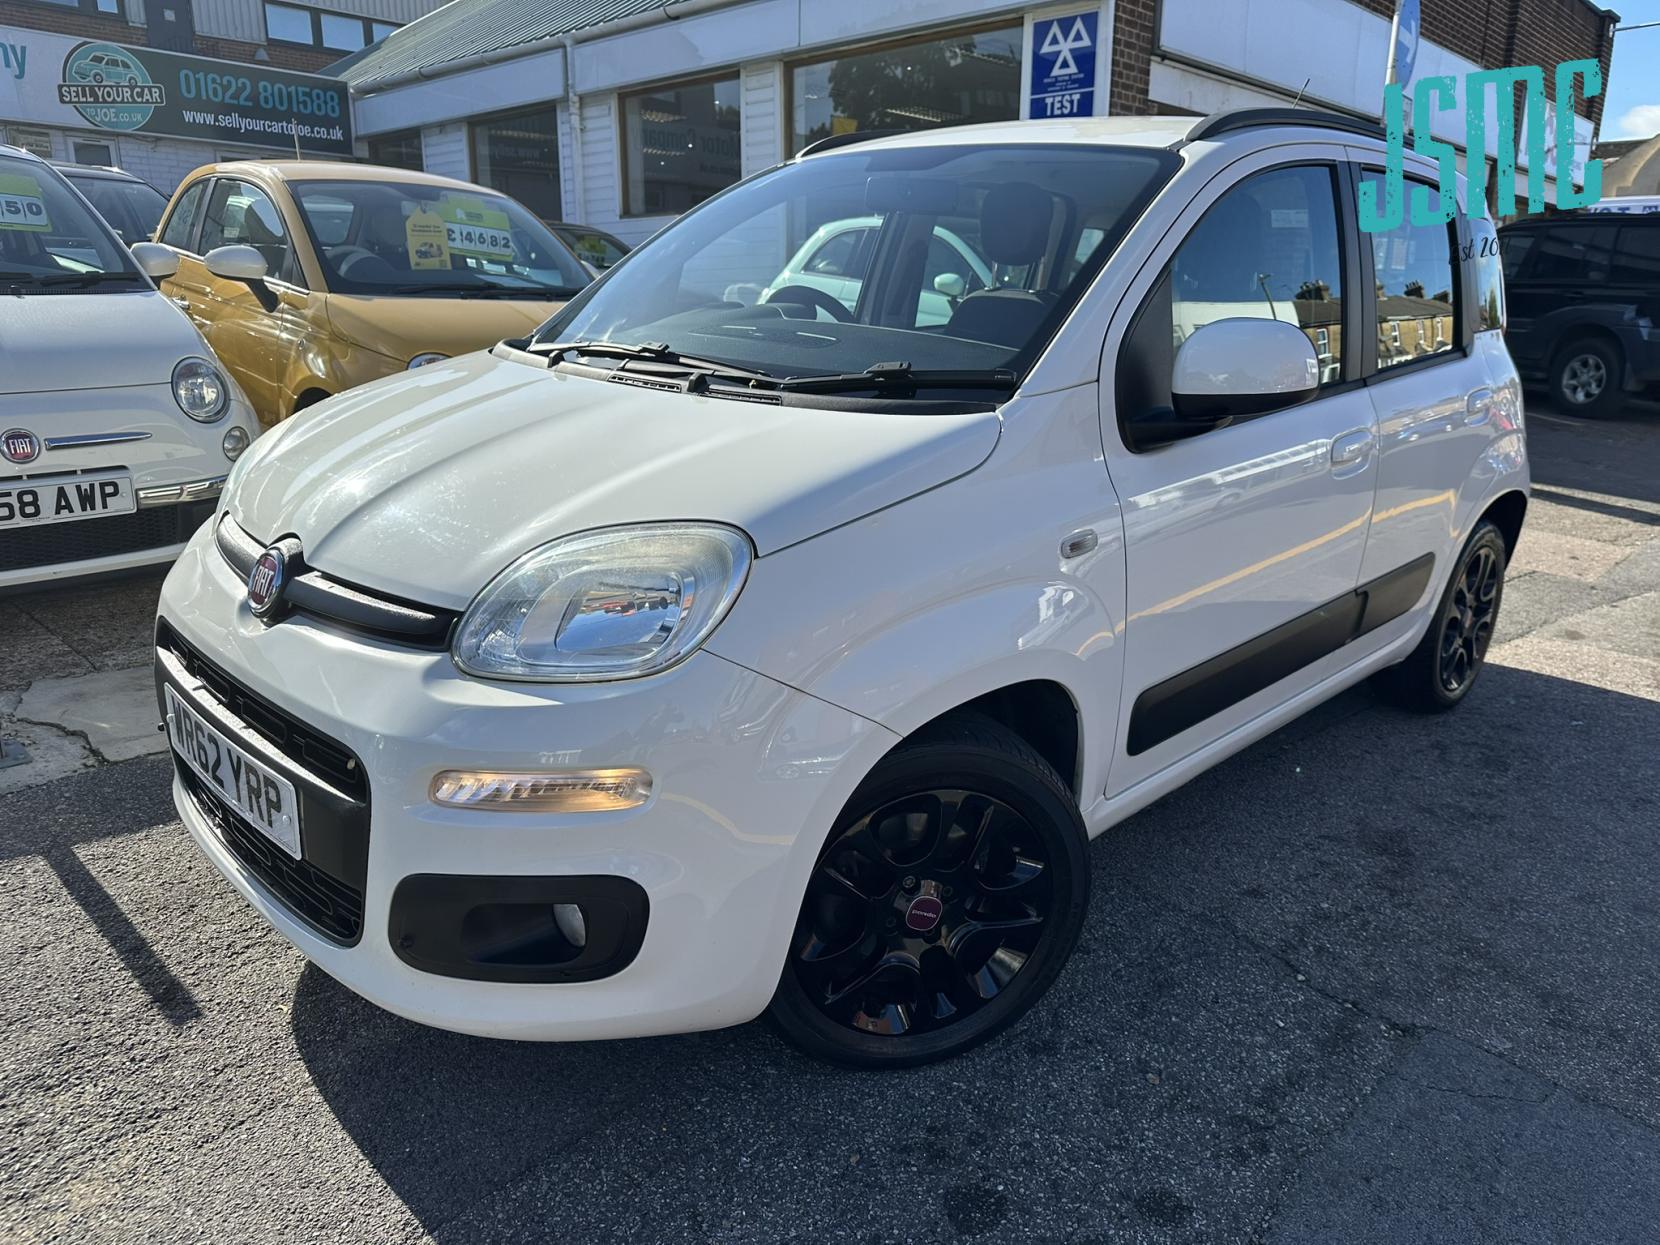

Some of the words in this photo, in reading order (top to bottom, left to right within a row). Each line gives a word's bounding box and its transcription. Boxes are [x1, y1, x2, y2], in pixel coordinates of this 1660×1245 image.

[61, 86, 94, 102] SELL
[95, 87, 133, 102] YOUR
[133, 88, 161, 103] CAR
[179, 68, 254, 107] 01622
[258, 80, 340, 119] 801588
[1045, 93, 1080, 116] TEST
[8, 438, 31, 454] FIAT
[54, 481, 120, 515] AWP
[252, 565, 275, 597] FIAT
[170, 693, 225, 790] WR62
[227, 748, 282, 829] YRP
